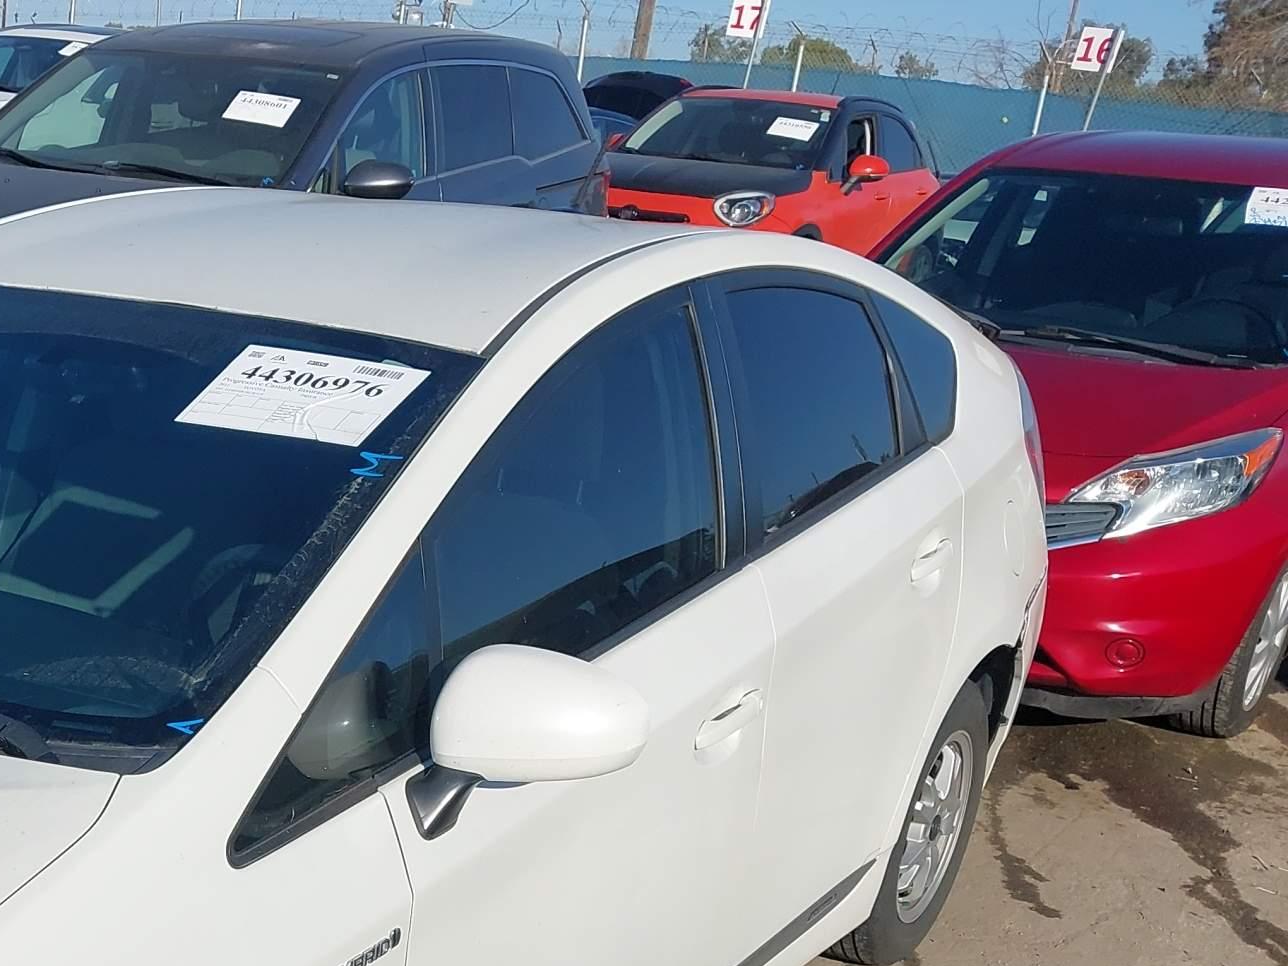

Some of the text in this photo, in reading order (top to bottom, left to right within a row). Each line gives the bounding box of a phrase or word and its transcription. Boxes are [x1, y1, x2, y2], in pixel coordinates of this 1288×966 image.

[730, 4, 761, 31] 17
[1076, 36, 1113, 65] 16
[223, 377, 263, 387] Progressive
[265, 382, 296, 392] Casualty
[298, 386, 334, 397] Insurance
[240, 364, 392, 399] 44306976
